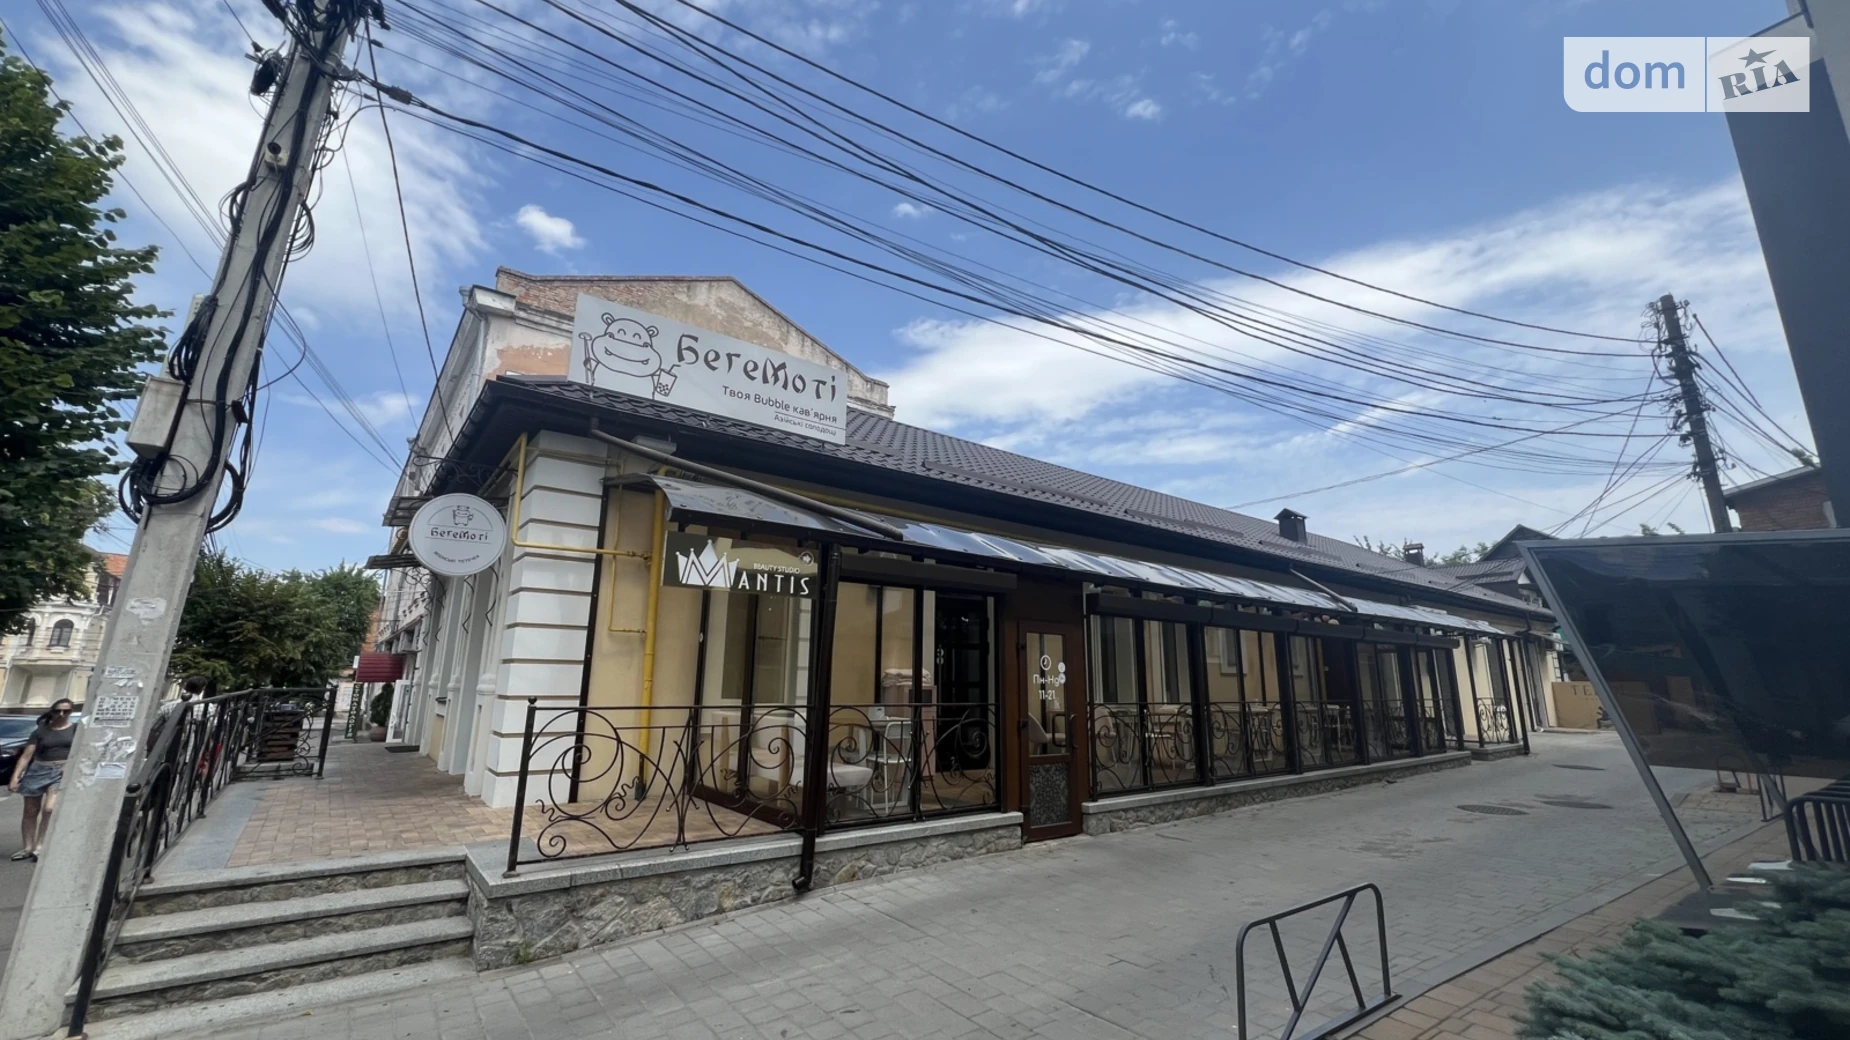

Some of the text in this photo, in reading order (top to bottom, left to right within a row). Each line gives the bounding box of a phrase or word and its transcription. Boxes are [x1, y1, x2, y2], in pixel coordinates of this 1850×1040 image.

[722, 385, 751, 401] Твоя
[754, 393, 790, 411] Bubble
[753, 562, 801, 575] BEAUTY STUDIO
[1038, 689, 1056, 700] 11-21
